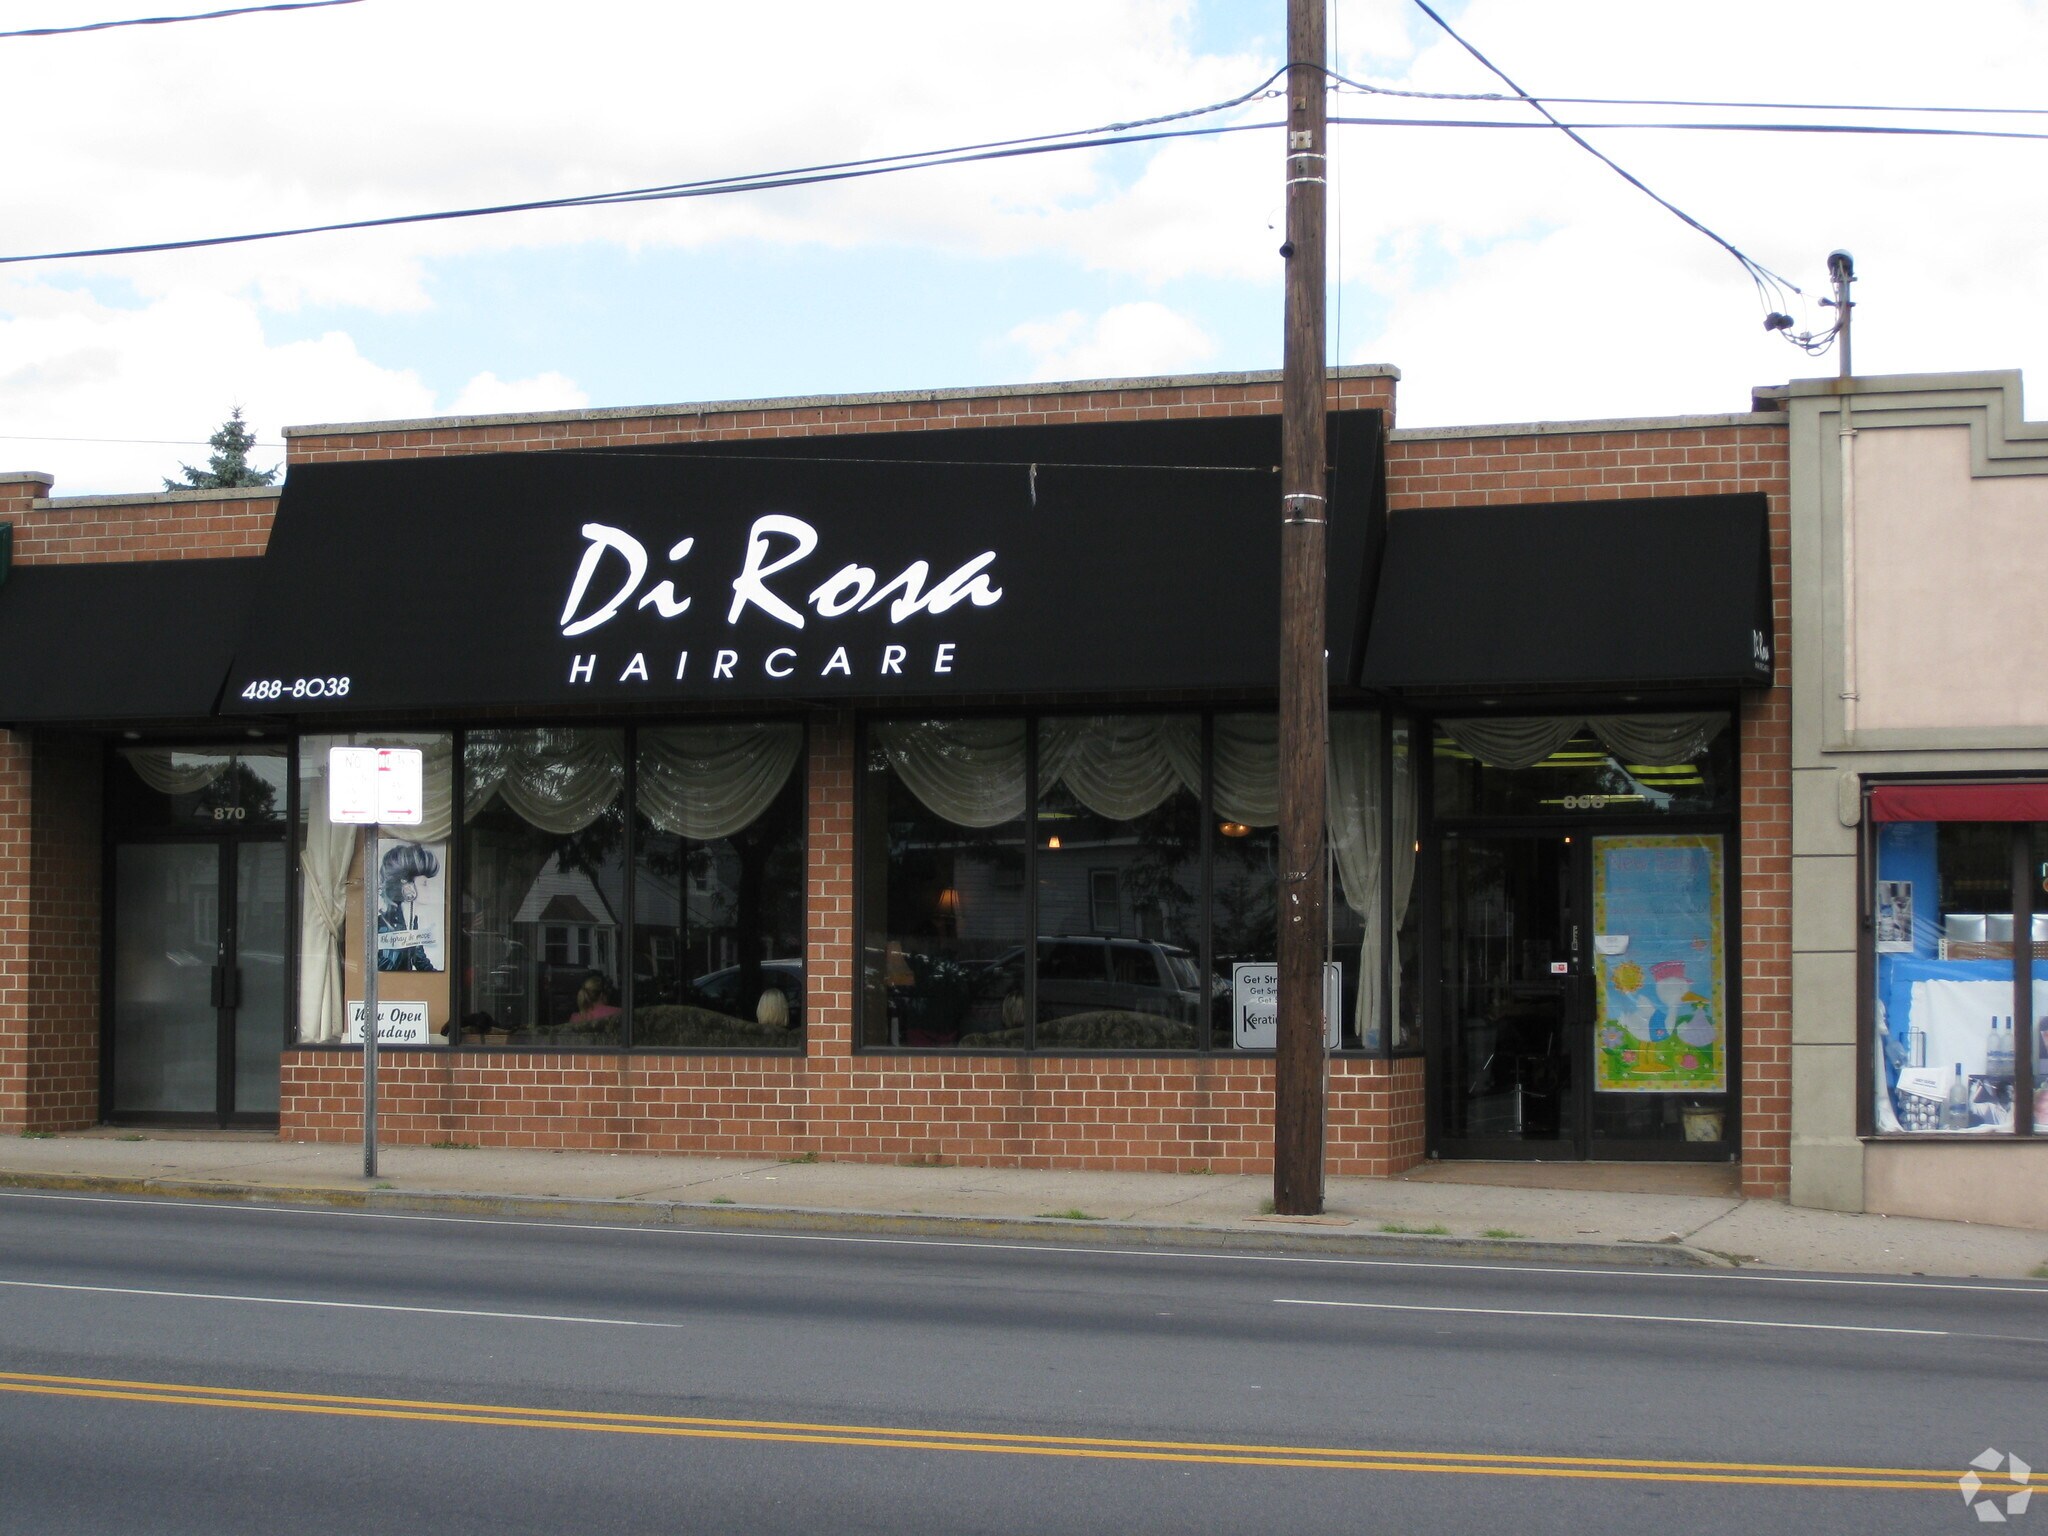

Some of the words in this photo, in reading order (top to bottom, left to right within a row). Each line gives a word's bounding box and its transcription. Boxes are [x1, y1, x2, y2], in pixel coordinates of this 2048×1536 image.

[560, 523, 694, 637] Di
[727, 514, 1003, 630] Rosa
[568, 643, 957, 684] HAIRCARE
[241, 676, 352, 701] 488-8038
[1563, 795, 1605, 809] 868
[214, 807, 246, 820] 870
[1243, 975, 1261, 984] Get
[1264, 975, 1278, 984] Str
[1250, 987, 1264, 995] Get
[1267, 987, 1278, 995] Sm
[354, 1007, 385, 1022] Nw
[390, 1007, 422, 1025] Open
[1243, 1005, 1278, 1033] Kerati
[359, 1025, 417, 1042] Sndays
